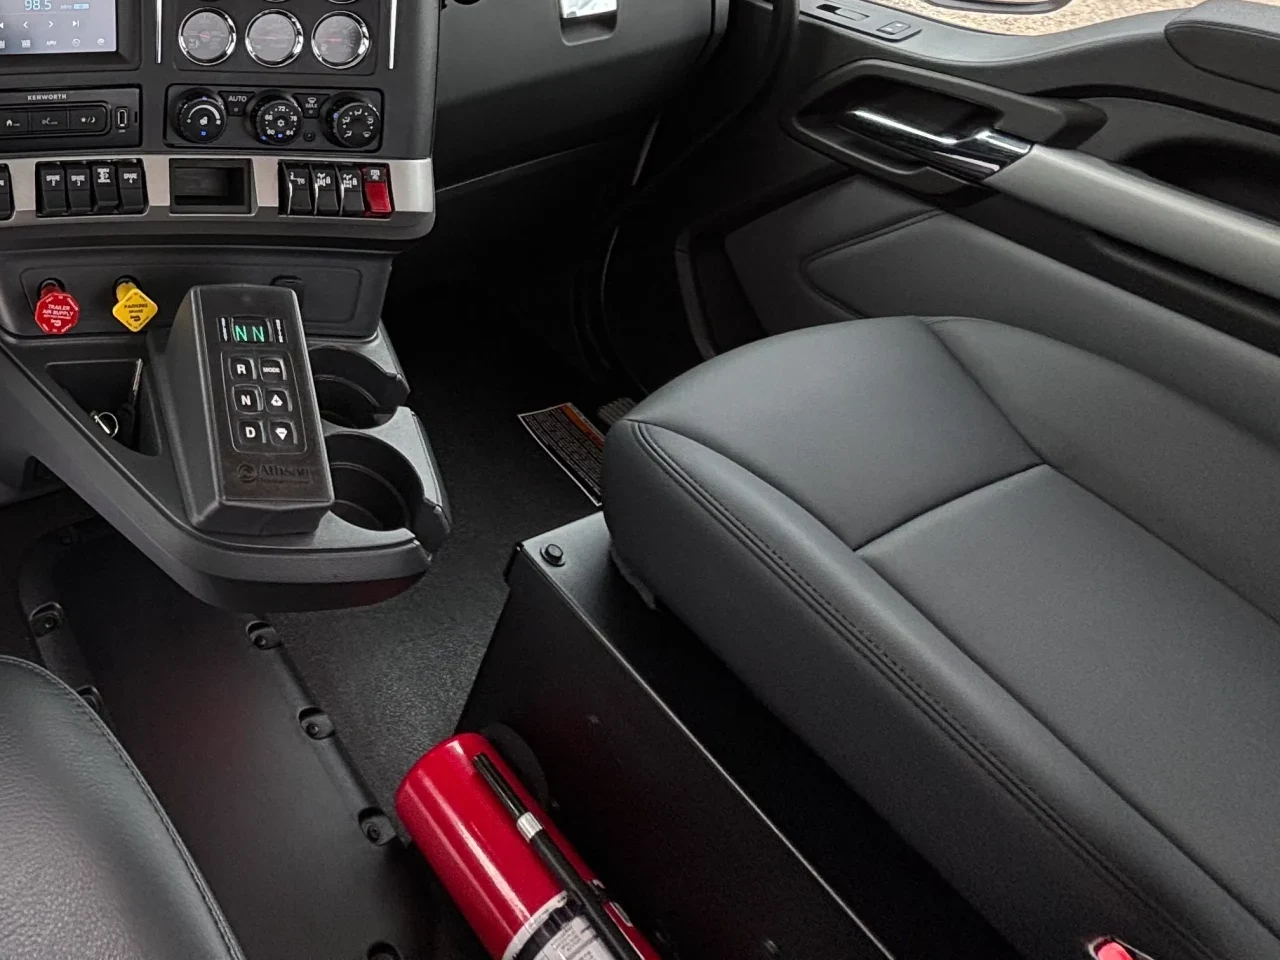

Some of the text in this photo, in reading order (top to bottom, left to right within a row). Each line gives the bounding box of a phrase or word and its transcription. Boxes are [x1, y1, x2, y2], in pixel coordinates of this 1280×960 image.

[24, 0, 52, 11] 98.5
[27, 93, 67, 101] KENWORTH
[228, 95, 247, 103] AUTO
[235, 325, 247, 341] N
[252, 326, 264, 342] N
[236, 364, 246, 375] R
[241, 395, 251, 406] N
[245, 427, 256, 438] D
